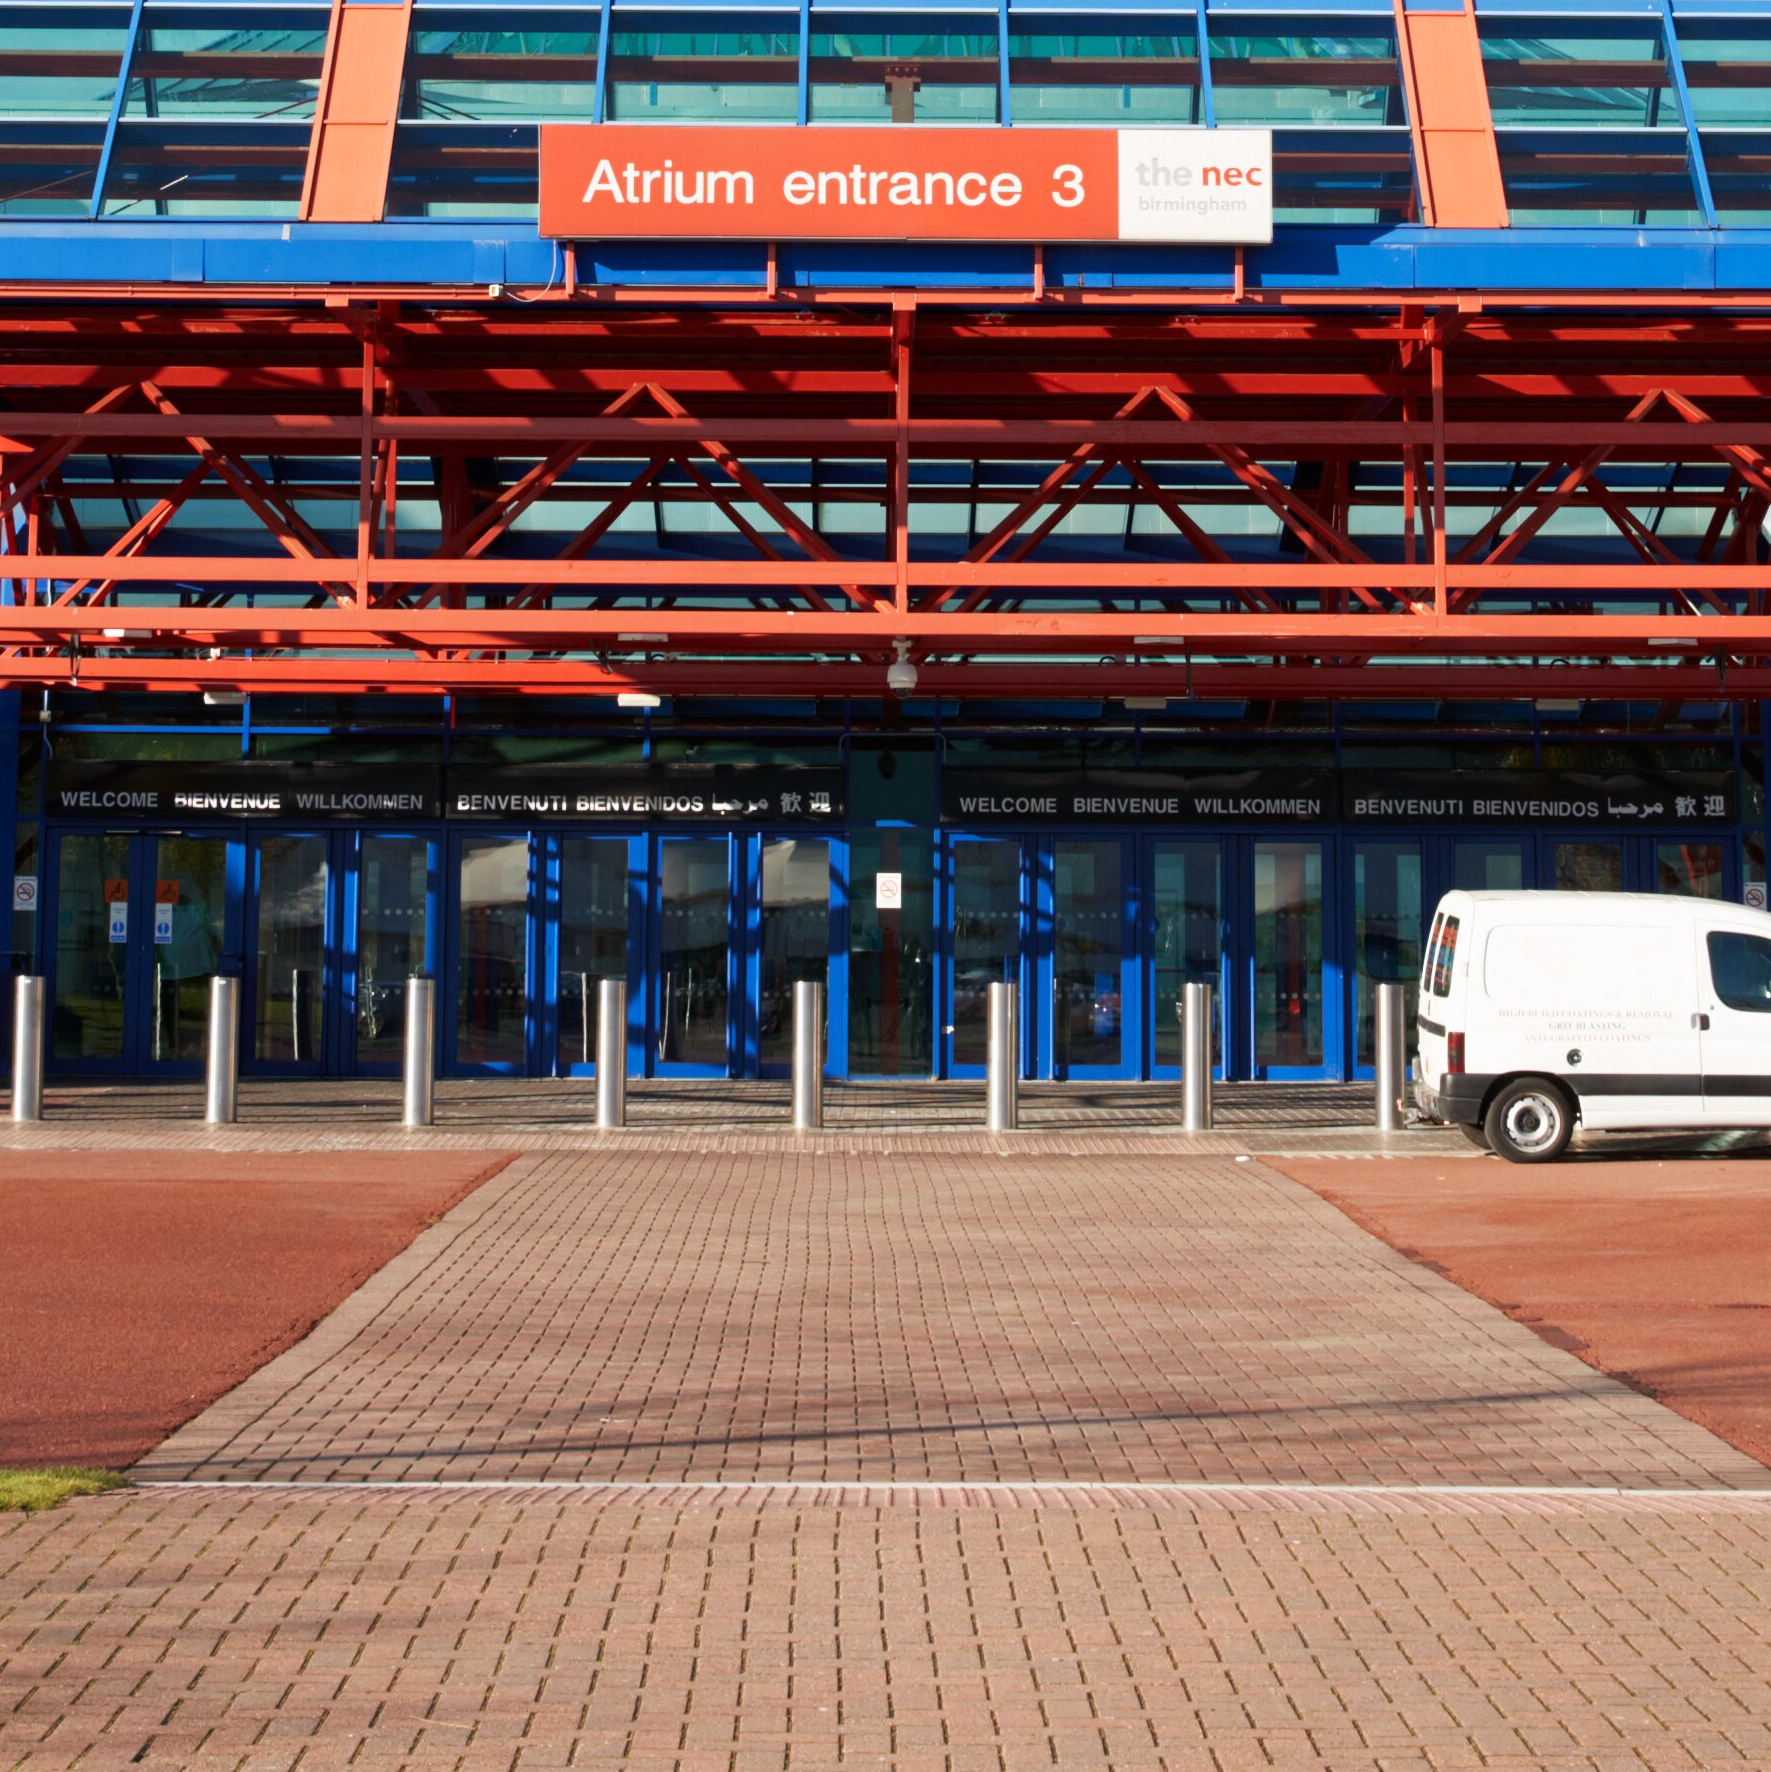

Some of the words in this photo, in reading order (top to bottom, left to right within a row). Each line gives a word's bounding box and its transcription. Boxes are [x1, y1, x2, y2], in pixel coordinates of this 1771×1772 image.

[1134, 157, 1193, 187] the
[1201, 165, 1264, 187] nec
[582, 158, 755, 205] Atrium
[782, 163, 1024, 207] entrance
[1050, 163, 1086, 208] 3
[1138, 195, 1248, 216] birmingham
[61, 791, 159, 808] WELCOME
[174, 792, 281, 810] BIENVENUE
[296, 793, 423, 810] WILLKOMMEN
[456, 794, 568, 812] BENVENUTI
[575, 795, 705, 813] BIENVENIDOS
[711, 792, 769, 816] مرحبا
[959, 797, 1057, 813] WELCOME
[1073, 798, 1179, 814] BIENVENUE
[1194, 799, 1321, 815] WILLKOMMEN
[1354, 799, 1463, 815] BENVENUTI
[1472, 800, 1598, 817] BIENVENIDOS
[1607, 795, 1664, 819] مرحبا
[1561, 1010, 1613, 1019] COATINGS
[1626, 1010, 1675, 1020] REMOVAL
[1548, 1021, 1573, 1031] GRIT
[1576, 1022, 1627, 1031] BLASTING
[1599, 1034, 1652, 1044] COATINGS
